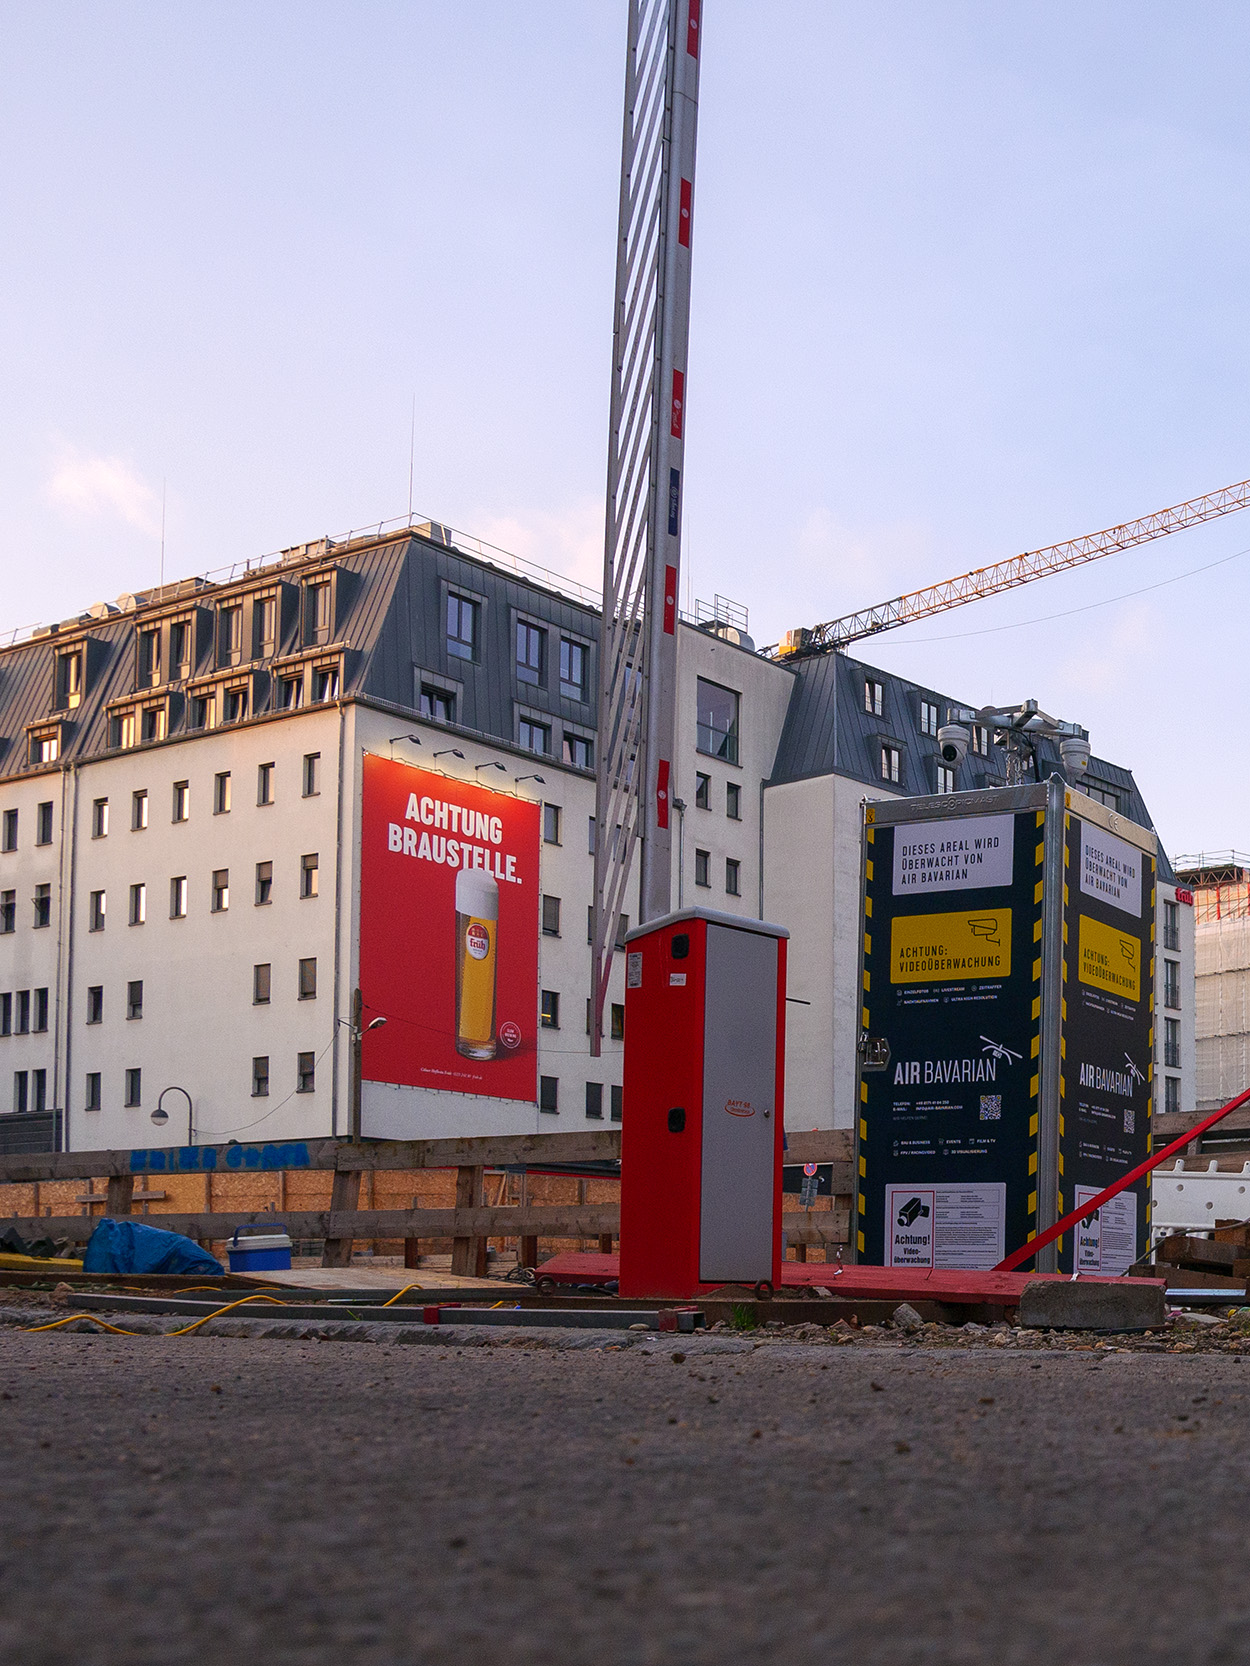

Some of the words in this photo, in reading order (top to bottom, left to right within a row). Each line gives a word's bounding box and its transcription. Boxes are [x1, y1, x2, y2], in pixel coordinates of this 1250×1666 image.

[405, 793, 502, 844] ACHTUNG
[388, 823, 522, 884] BRAUSTELLE.
[902, 843, 936, 857] DIESES
[939, 840, 970, 853] AREAL
[974, 837, 1000, 849] WIRD
[901, 854, 960, 871] ÜBERWACHT
[964, 853, 983, 865] VON
[1085, 845, 1104, 863] DIESES
[1105, 855, 1121, 871] AREAL
[1122, 863, 1136, 879] WIRD
[901, 873, 917, 885] AIR
[921, 869, 968, 883] BAVARIAN
[1085, 857, 1116, 882] ÜBERWACHT
[1117, 874, 1128, 888] VON
[1085, 873, 1094, 886] AIR
[1096, 878, 1121, 898] BAVARIAN
[899, 945, 948, 959] ACHTUNG:
[1083, 948, 1110, 967] ACHTUNG:
[899, 955, 1001, 973] VIDEOÜBERWACHUNG
[1083, 962, 1136, 990] VIDEOÜBERWACHUNG
[894, 1062, 920, 1085] AIR
[924, 1058, 997, 1084] BAVARIAN
[1079, 1062, 1094, 1089] AIR
[1095, 1066, 1133, 1097] BAVARIAN
[894, 1233, 930, 1245] Achtung!
[893, 1254, 931, 1265] überwachung
[903, 1247, 921, 1256] Video-
